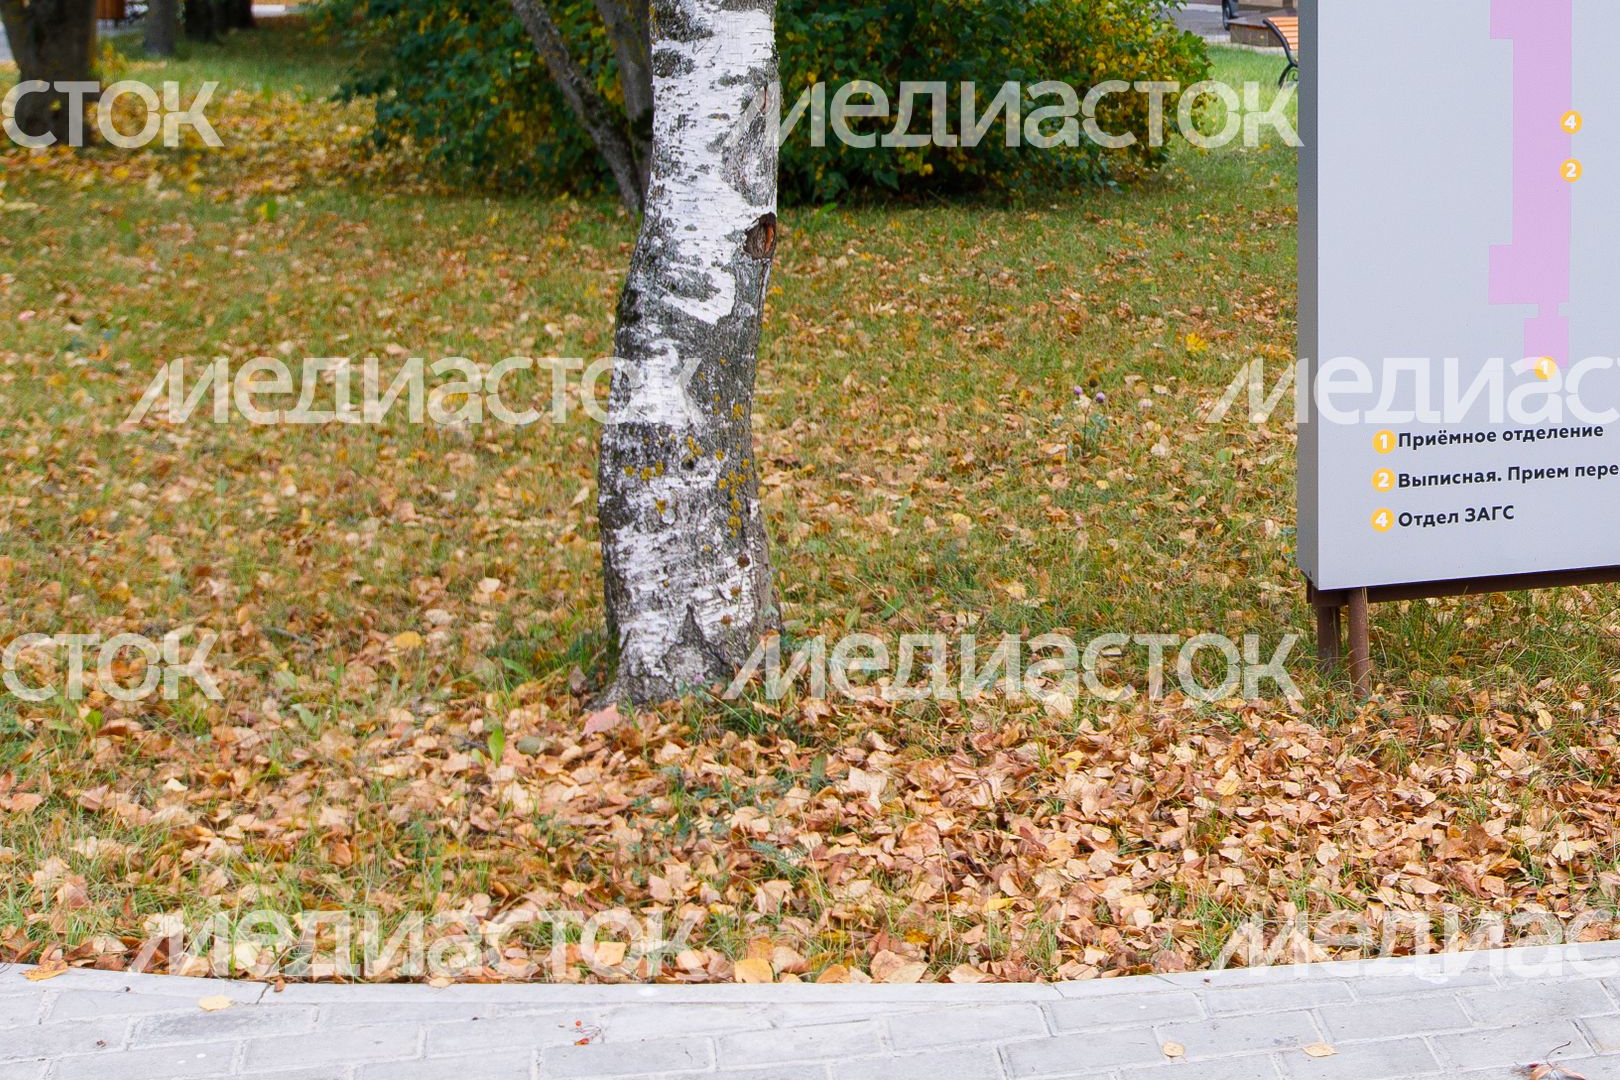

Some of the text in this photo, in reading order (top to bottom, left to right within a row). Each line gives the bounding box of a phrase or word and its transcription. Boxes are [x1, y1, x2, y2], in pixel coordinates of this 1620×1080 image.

[1564, 114, 1577, 130] 4
[1566, 162, 1577, 178] 2
[1398, 429, 1497, 451] Приёмное
[1502, 425, 1604, 443] отделение
[1378, 472, 1389, 488] 2
[1398, 471, 1502, 489] Выписная.
[1507, 466, 1569, 484] Прием
[1375, 504, 1515, 530] 4 Отдел ЗАГС
